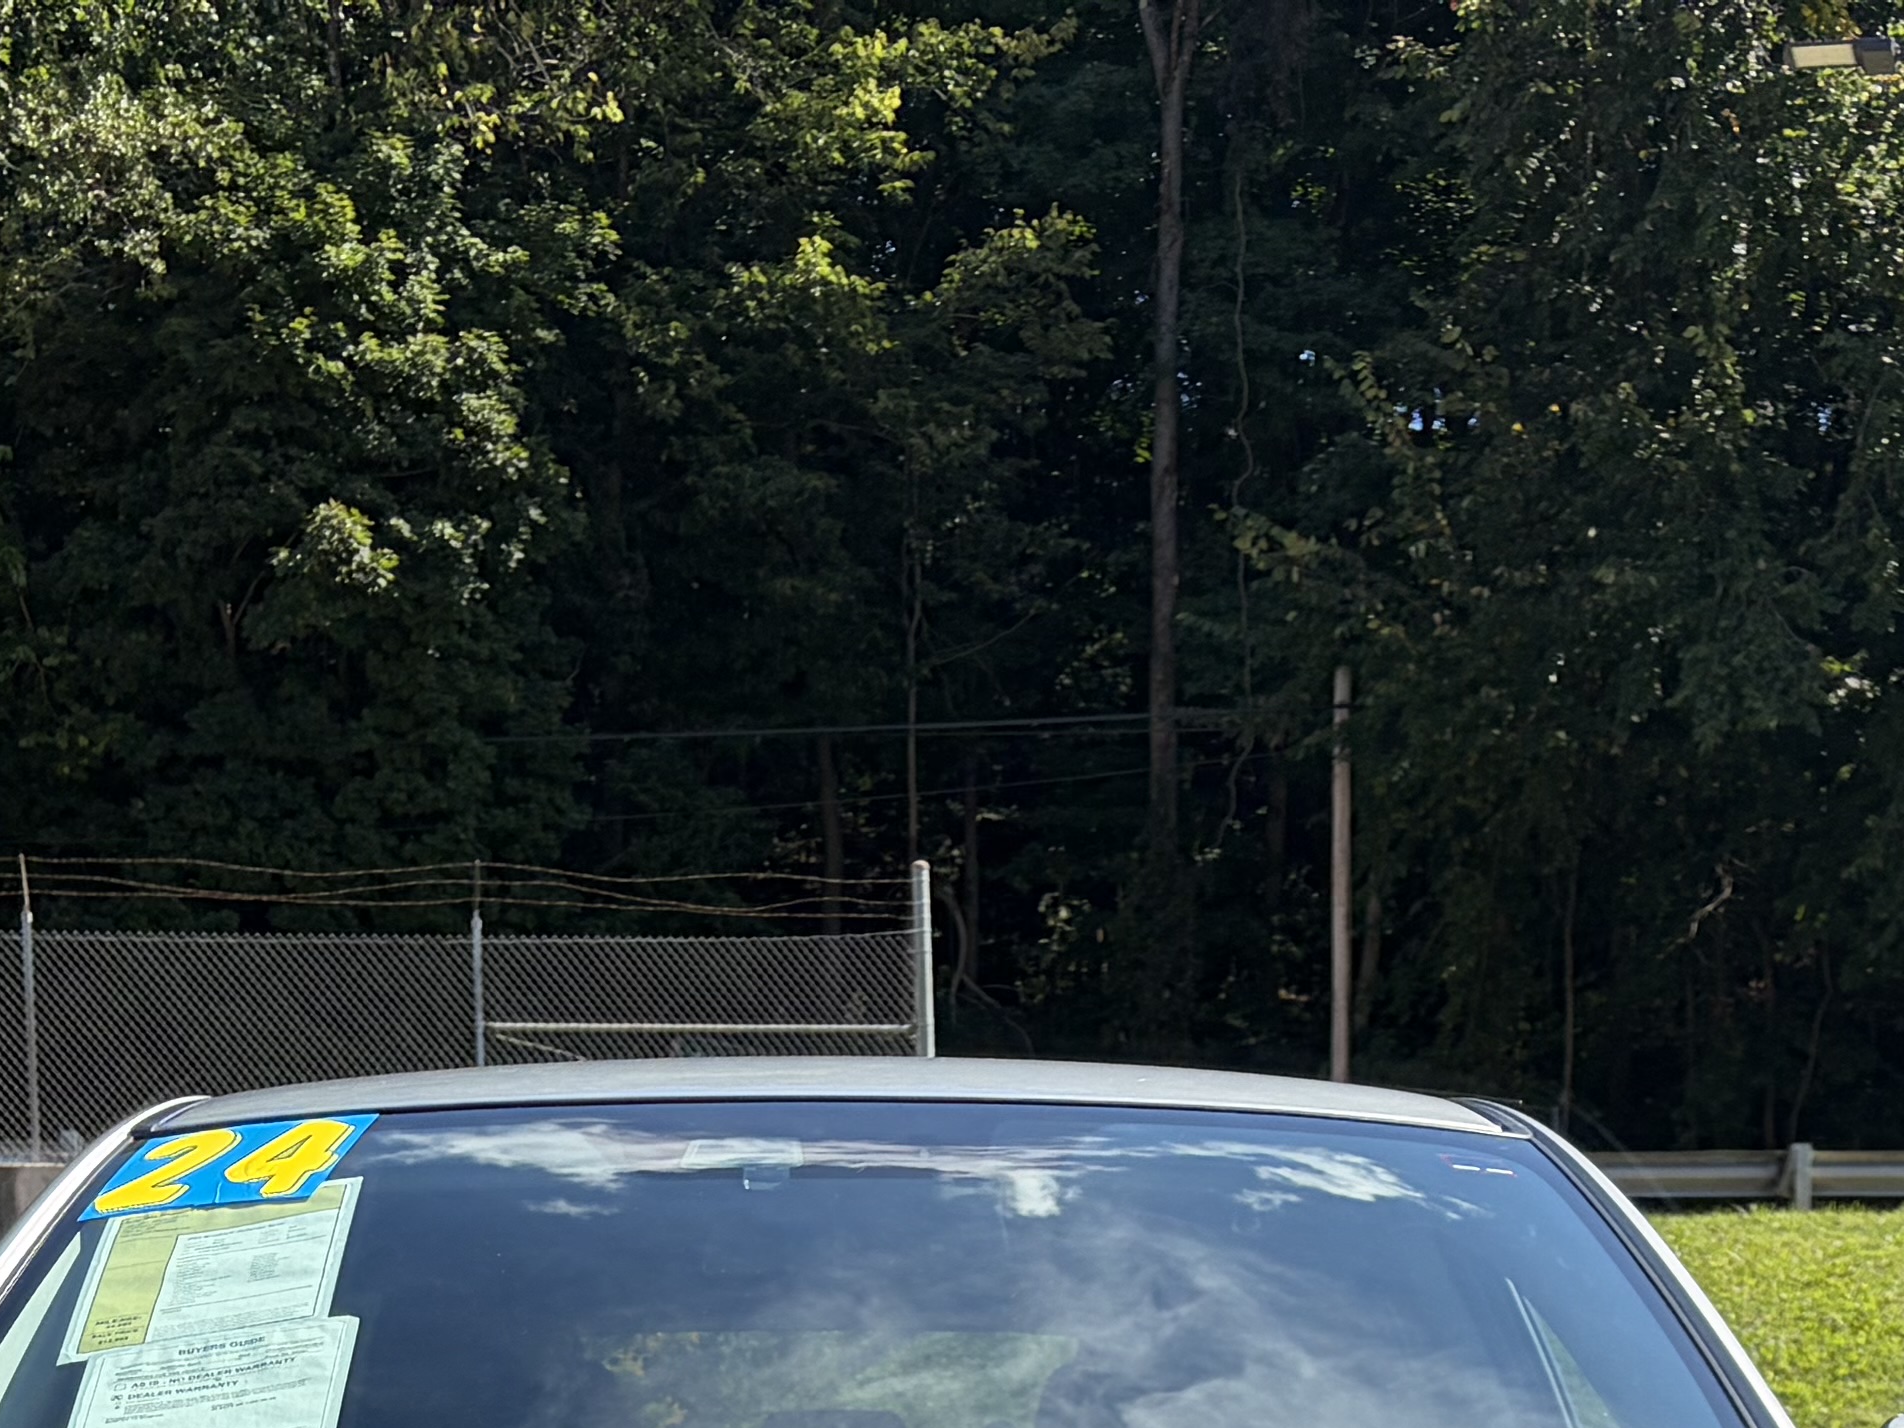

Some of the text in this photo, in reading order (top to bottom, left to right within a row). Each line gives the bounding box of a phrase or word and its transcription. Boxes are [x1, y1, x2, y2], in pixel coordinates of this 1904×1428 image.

[94, 1118, 356, 1214] 24
[178, 1343, 226, 1355] BUYERS
[229, 1336, 265, 1348] GUIDE
[188, 1369, 232, 1381] DEALER
[235, 1356, 296, 1373] WARRANTY
[128, 1390, 172, 1400] DEALER
[175, 1380, 238, 1394] WARRANTY
